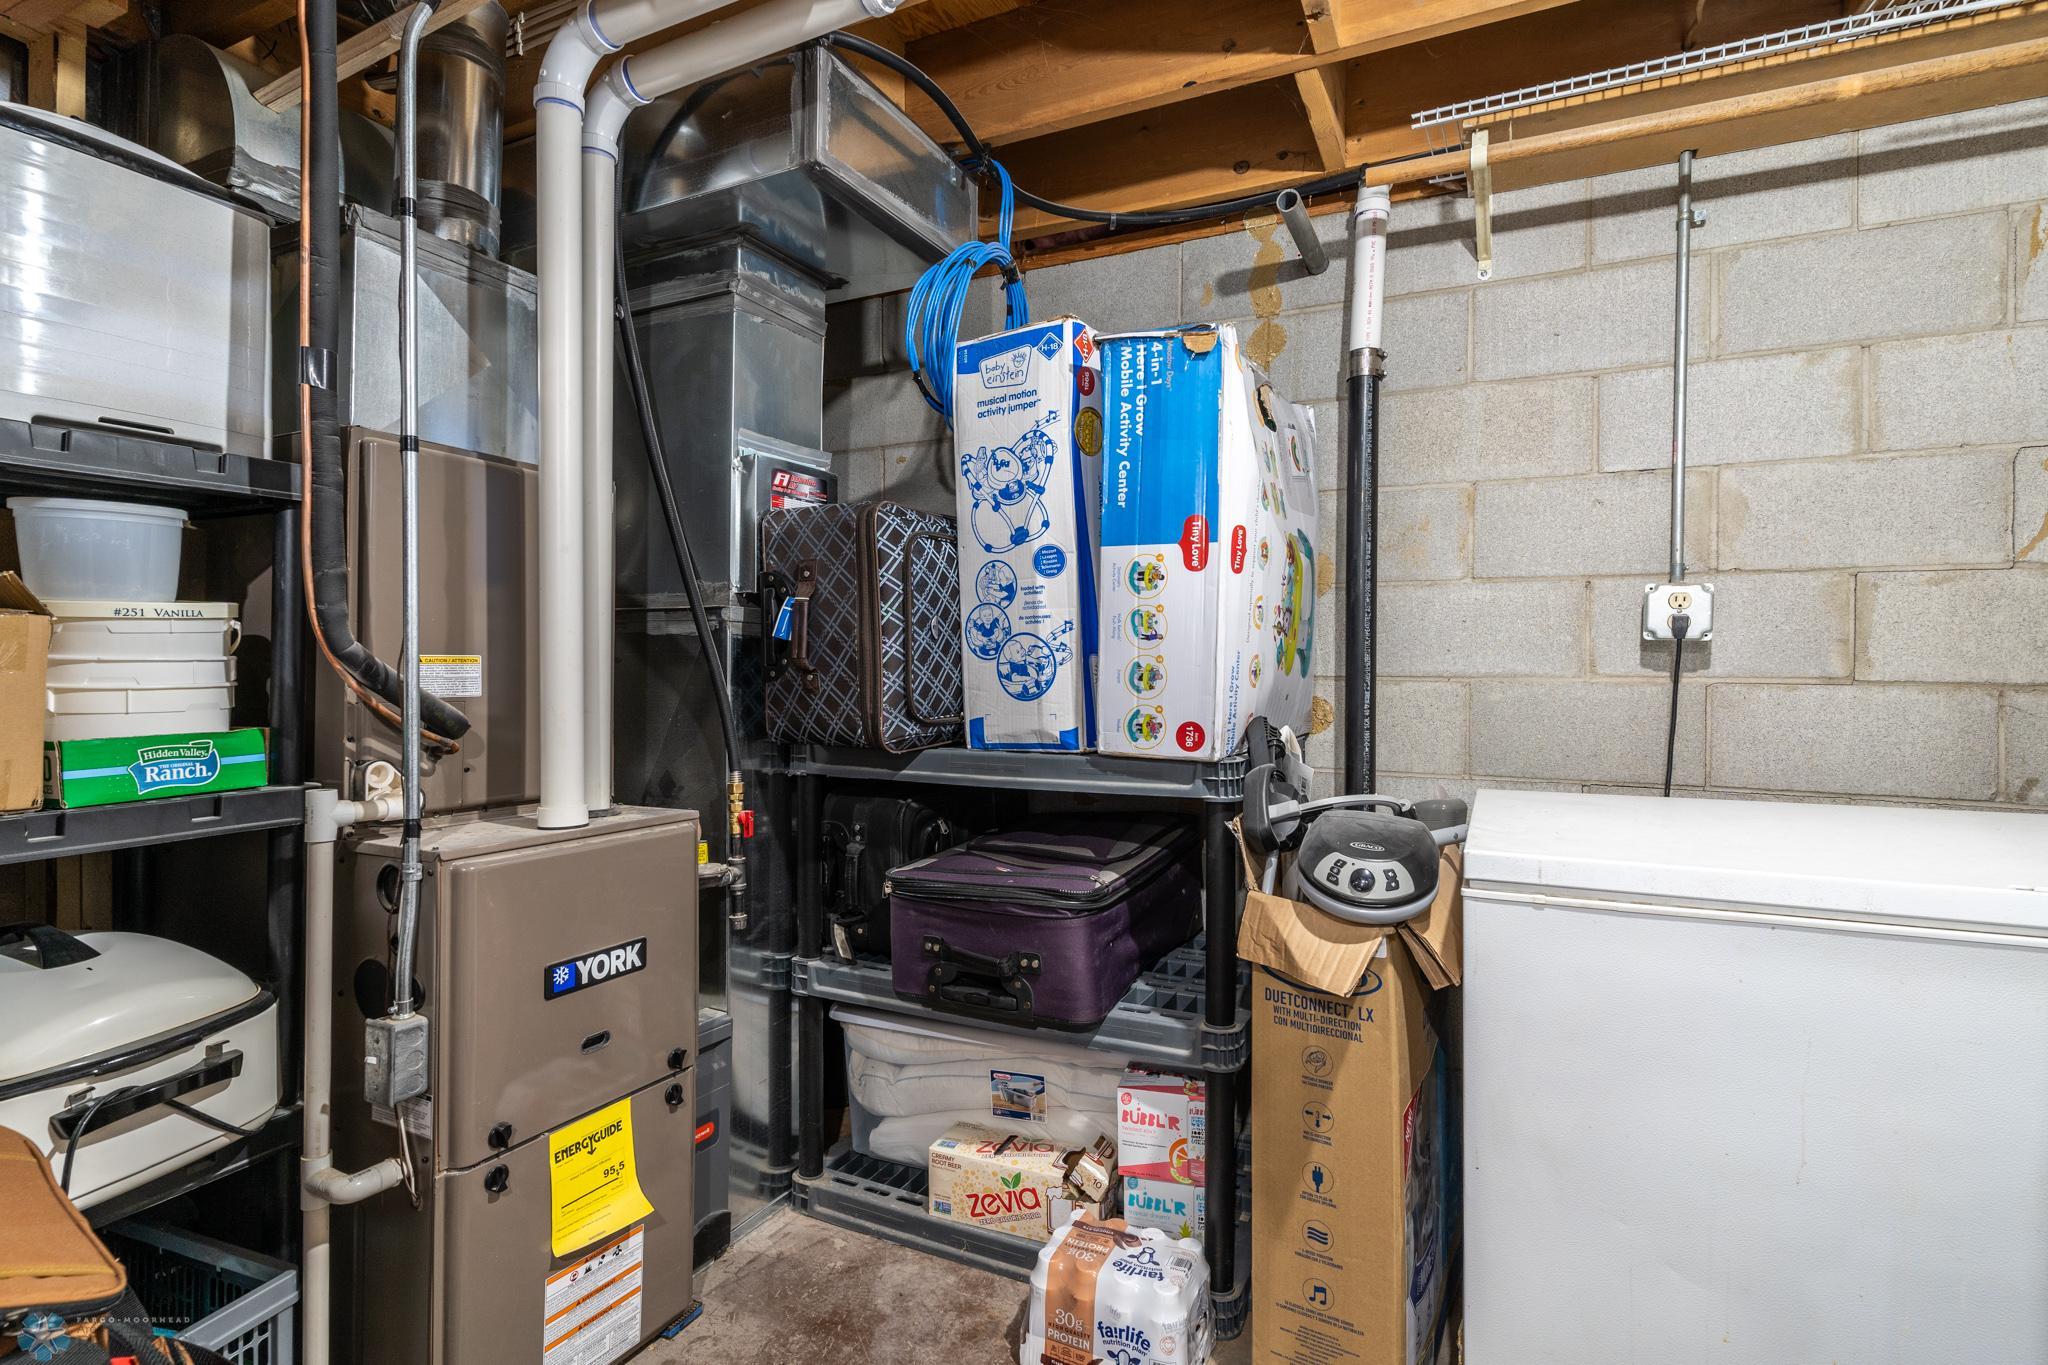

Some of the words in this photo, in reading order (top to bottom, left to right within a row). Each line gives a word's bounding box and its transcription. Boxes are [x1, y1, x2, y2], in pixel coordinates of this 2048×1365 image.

[1041, 343, 1058, 351] H-18
[985, 361, 1006, 375] baby
[1120, 346, 1133, 397] Mobile
[1136, 344, 1146, 381] Here
[1151, 341, 1163, 385] 4-in-1
[986, 367, 1024, 384] einstein
[976, 392, 1007, 408] musical
[1008, 388, 1037, 401] motion
[977, 403, 1007, 419] activity
[1135, 393, 1148, 436] Grow
[1116, 401, 1133, 457] Activity
[1117, 460, 1131, 508] Center
[1190, 520, 1201, 543] Tiny
[1191, 544, 1201, 567] Love
[1234, 551, 1242, 569] Tiny
[113, 607, 145, 617] #251
[154, 608, 204, 617] VANILLA
[1232, 684, 1240, 719] Activity
[1185, 726, 1194, 747] 1736
[143, 749, 180, 760] Hidden
[575, 942, 642, 985] YORK
[1273, 1004, 1291, 1017] WITH
[1293, 1008, 1362, 1032] MULTI-DIRECTION
[1358, 1006, 1374, 1023] LX
[1273, 1015, 1288, 1027] CON
[1289, 1019, 1364, 1043] MULTIDIRECCIONAL
[554, 1120, 622, 1164] ENERGYGUIDE
[931, 1152, 955, 1162] CREAMY
[931, 1158, 947, 1167] ROOT
[947, 1160, 962, 1169] BEER
[603, 1161, 625, 1178] 95.5
[965, 1187, 1042, 1218] zevia
[1021, 1211, 1042, 1221] SODA
[1066, 1237, 1110, 1253] PROTEIN
[1067, 1247, 1097, 1262] 30g
[1112, 1260, 1166, 1282] fairlife
[1055, 1308, 1083, 1332] 30g
[1047, 1328, 1090, 1350] PROTEIN
[1097, 1320, 1151, 1351] fairlife
[1102, 1338, 1131, 1349] nutrition
